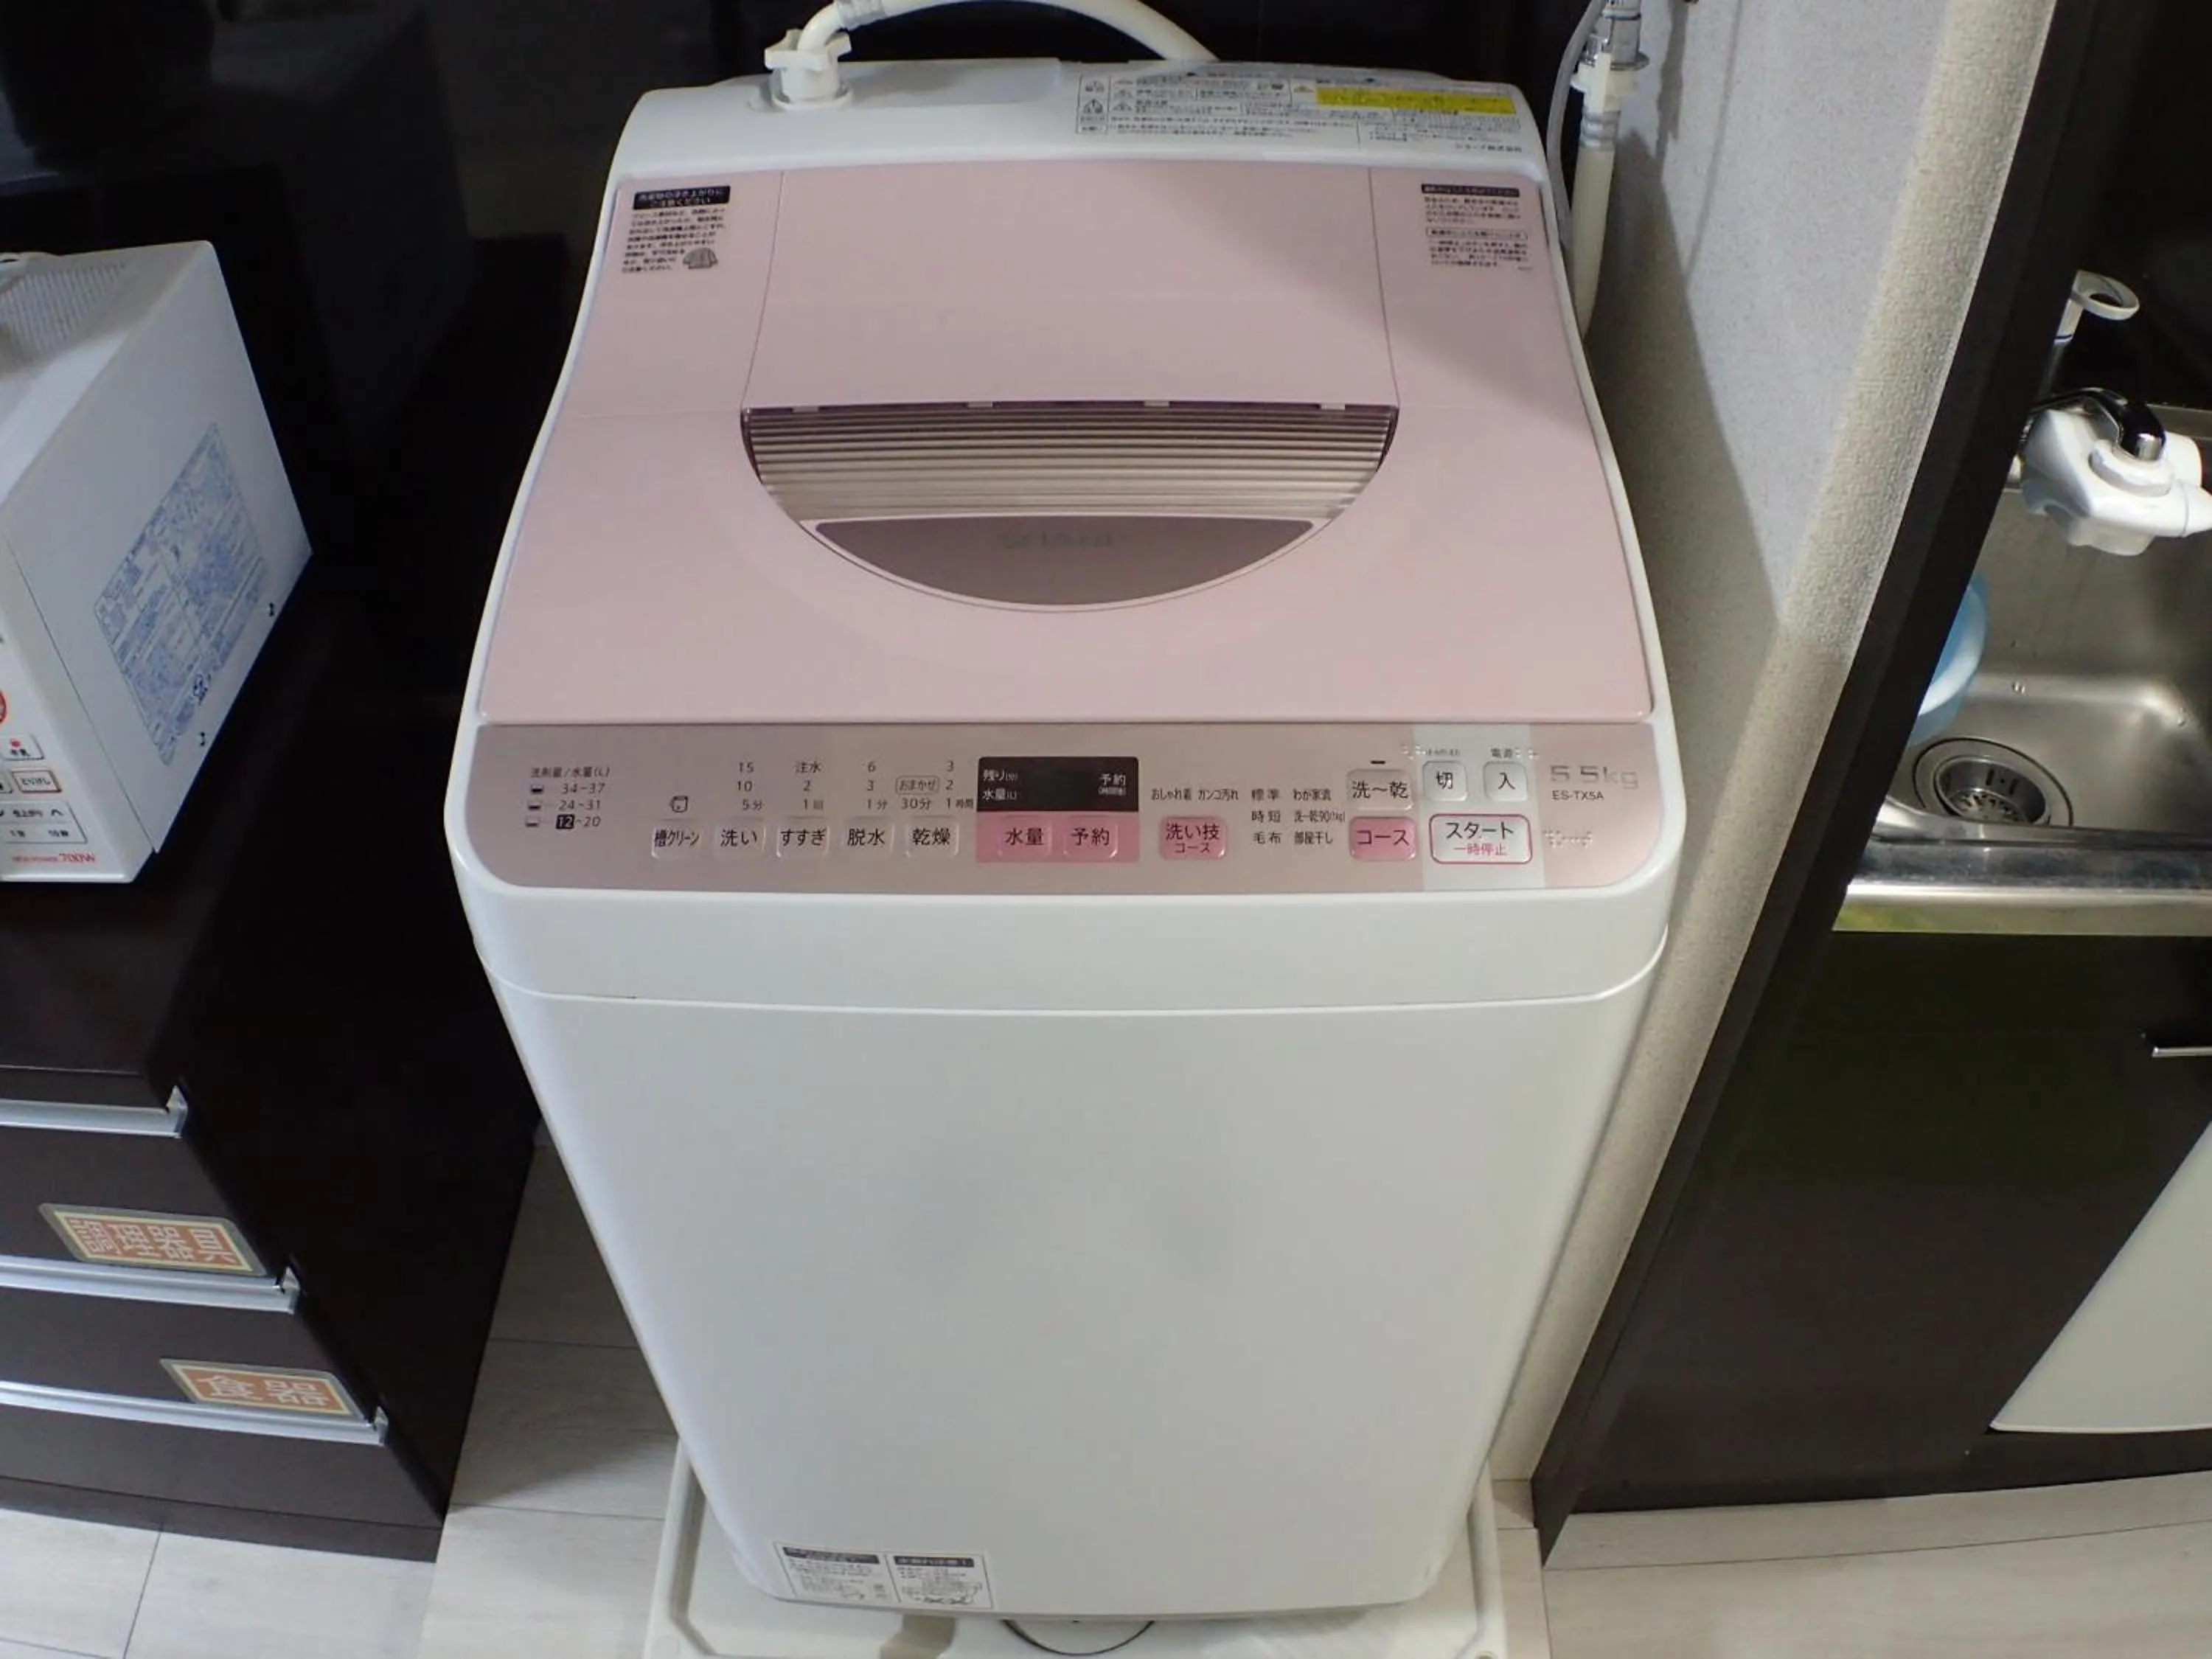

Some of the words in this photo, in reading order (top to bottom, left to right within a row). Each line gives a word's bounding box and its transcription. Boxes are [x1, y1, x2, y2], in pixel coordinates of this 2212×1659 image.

[740, 762, 754, 773] 15
[796, 761, 822, 773] 注水
[868, 762, 876, 772] 6
[947, 761, 955, 772] 3
[945, 779, 953, 790] 2
[1099, 773, 1127, 786] 予約
[1436, 772, 1455, 790] 切
[1498, 772, 1515, 790] 入
[1550, 765, 1639, 789] 55kg
[738, 781, 753, 792] 10
[803, 780, 811, 791] 2
[867, 781, 874, 792] 3
[1552, 790, 1604, 801] ES-TX5A
[901, 798, 932, 810] 30分
[781, 828, 826, 846] すすぎ
[847, 828, 886, 846] 脱水
[912, 827, 951, 845] 乾燥
[1005, 827, 1044, 846] 水量
[1071, 827, 1110, 846] 予約
[1166, 822, 1220, 841] 洗い技
[1357, 829, 1409, 846] コース
[1446, 821, 1514, 839] スタート
[654, 830, 700, 847] 槽クリーン
[720, 829, 757, 847] 洗い
[1254, 832, 1281, 844] 毛布
[1294, 832, 1334, 844] 部屋干し
[1175, 842, 1211, 853] コース
[1454, 845, 1507, 857] 一時停止
[70, 1219, 238, 1263] 調理器具
[197, 1374, 330, 1408] 食器
